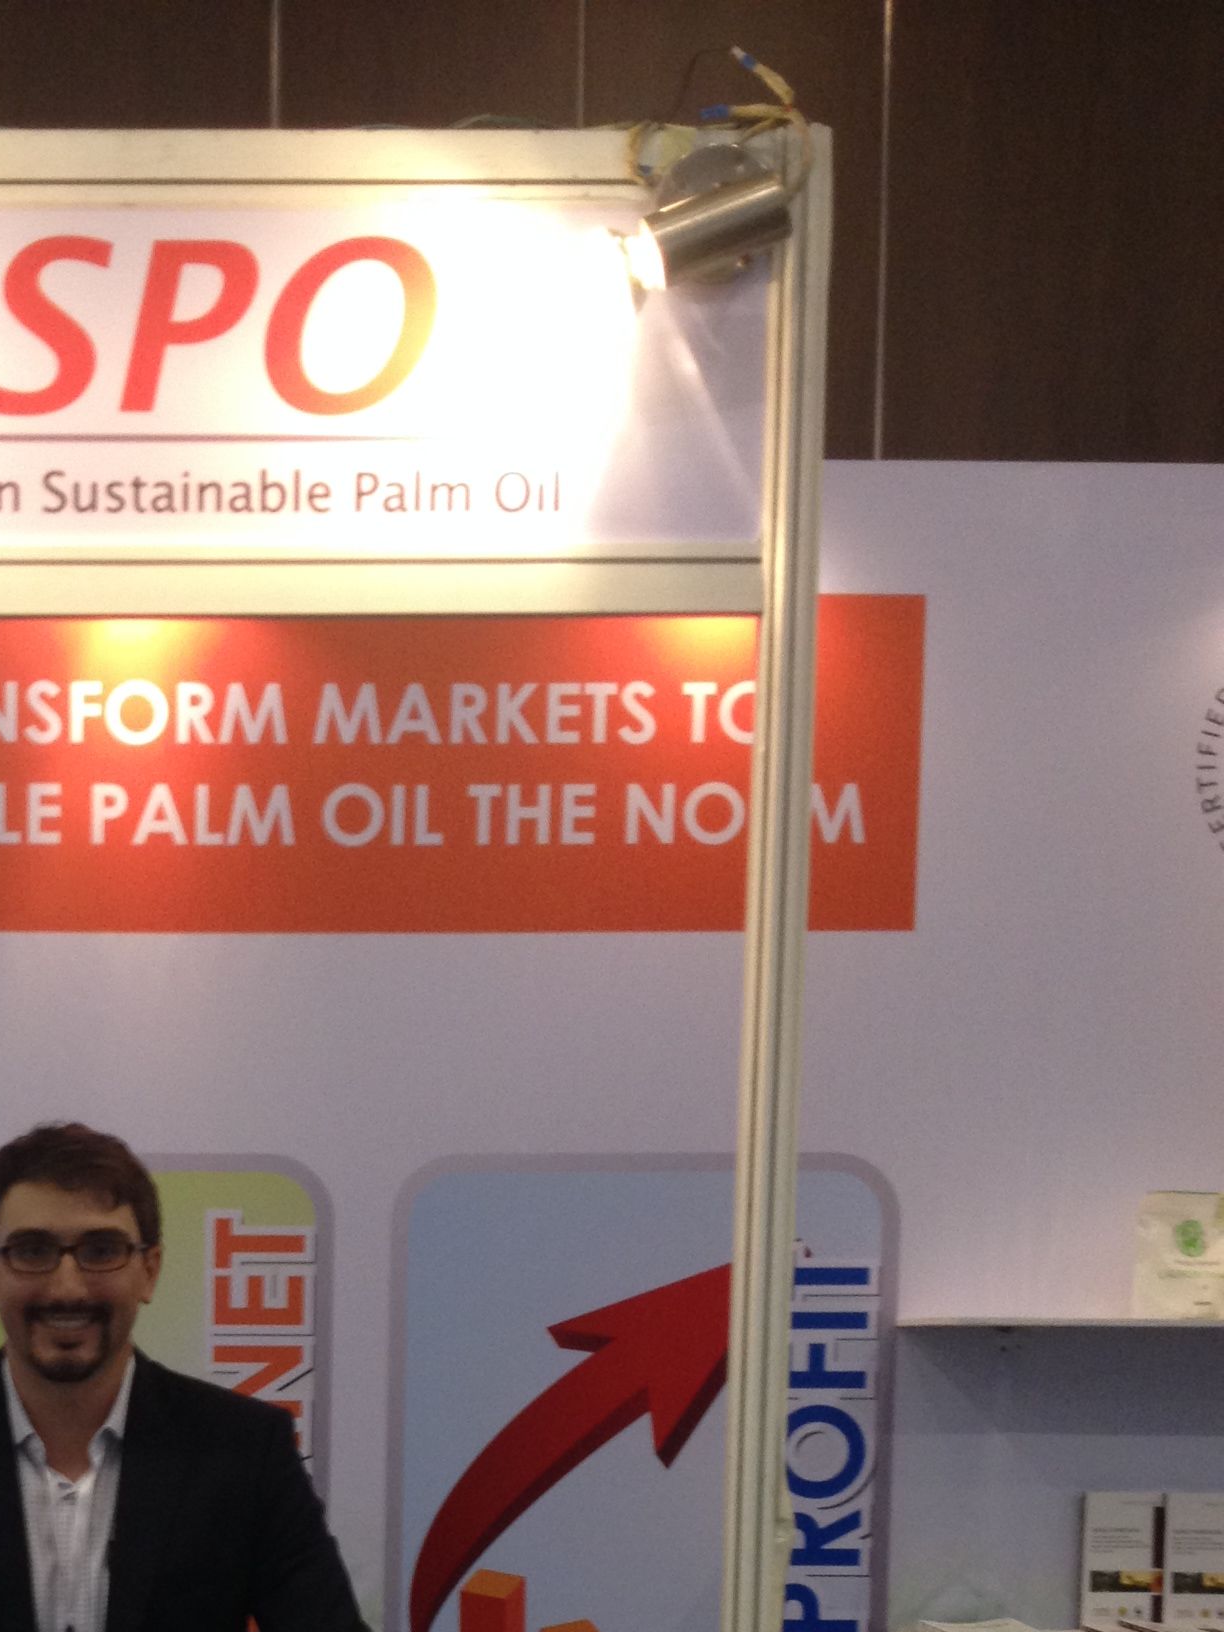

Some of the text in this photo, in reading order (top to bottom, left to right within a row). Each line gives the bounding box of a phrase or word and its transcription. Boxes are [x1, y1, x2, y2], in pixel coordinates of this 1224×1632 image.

[41, 469, 332, 513] Sustainable
[354, 471, 473, 513] Palm
[494, 472, 563, 514] Oil
[312, 681, 659, 746] MARKETS
[87, 782, 297, 847] PALM
[322, 782, 445, 847] OIL
[467, 783, 598, 847] THE
[625, 782, 867, 846] NOM
